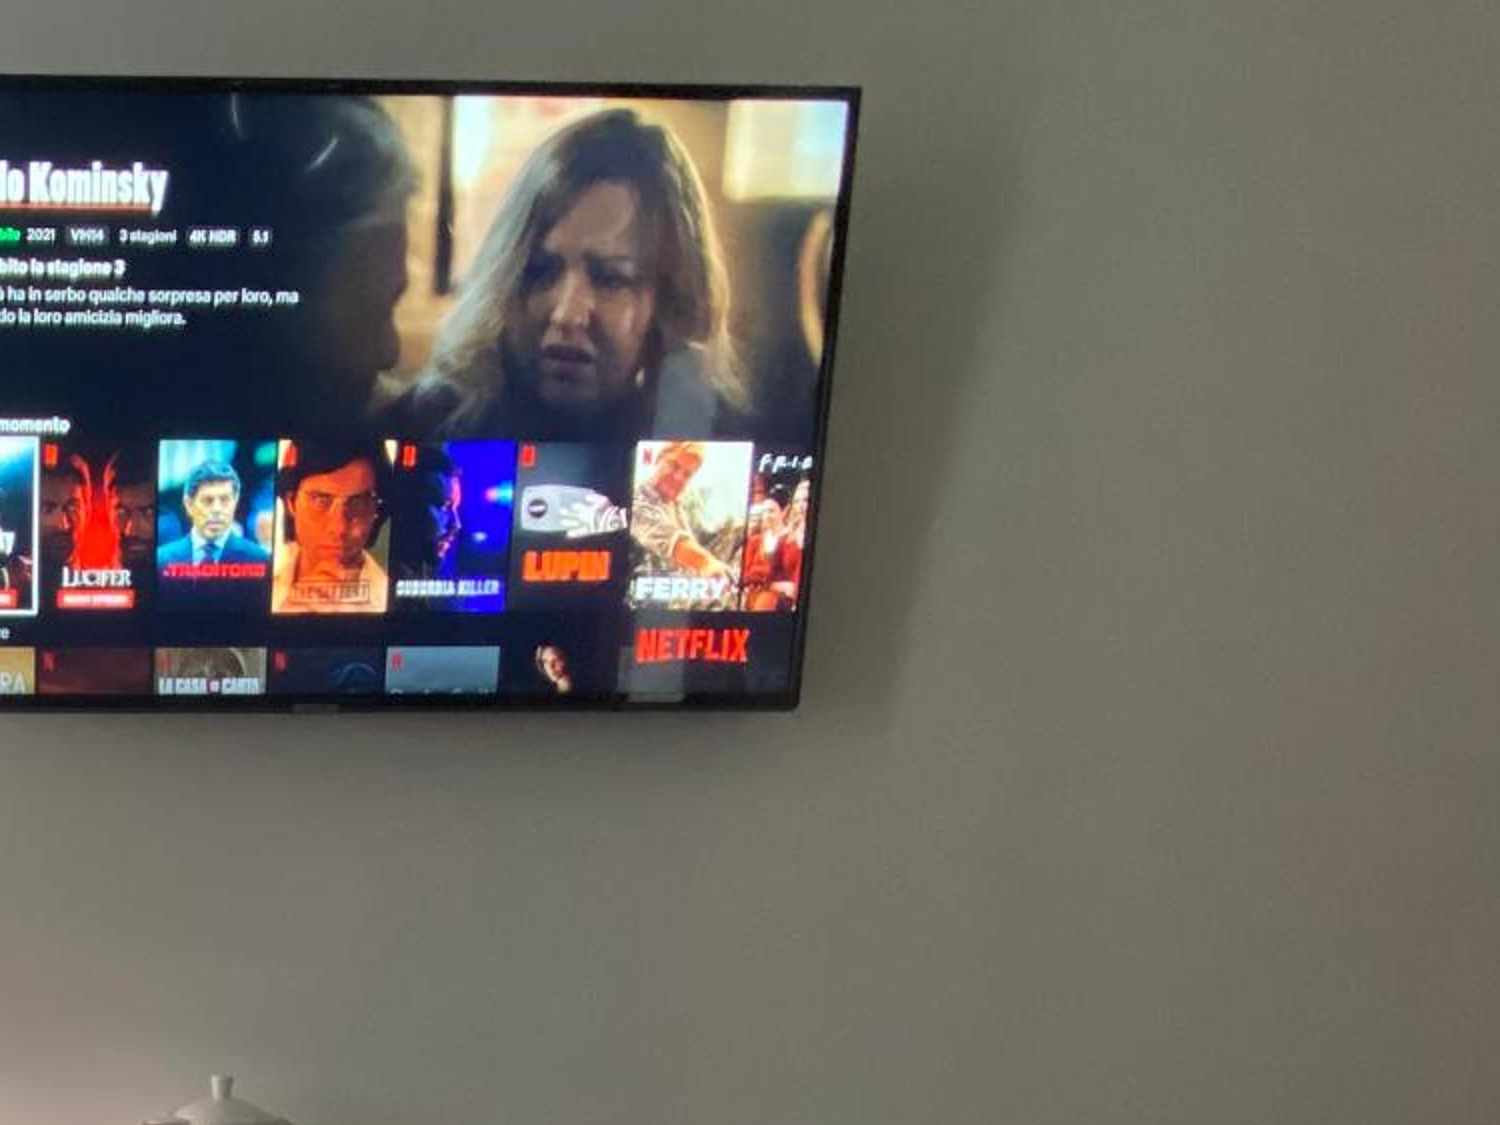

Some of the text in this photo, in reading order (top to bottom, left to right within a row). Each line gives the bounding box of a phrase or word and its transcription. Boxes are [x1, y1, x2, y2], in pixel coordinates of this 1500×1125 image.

[29, 160, 168, 215] Kominsky
[26, 228, 55, 241] 2021
[119, 229, 128, 242] 3
[129, 229, 177, 245] stagioni
[189, 230, 206, 243] 4K
[209, 230, 237, 243] HDR
[30, 258, 45, 276] la
[46, 258, 112, 281] stagione
[114, 259, 126, 277] 3
[7, 286, 26, 301] ha
[28, 286, 42, 301] in
[44, 286, 86, 301] serbo
[88, 286, 146, 305] qualche
[149, 289, 211, 306] sorpresa
[213, 290, 238, 308] per
[241, 288, 273, 306] loro,
[275, 290, 299, 303] ma
[18, 308, 31, 324] la
[33, 308, 63, 324] loro
[64, 309, 123, 325] amicizia
[125, 309, 187, 329] migliora.
[62, 566, 133, 588] LUCIFER
[522, 551, 611, 581] LUPIN
[635, 576, 726, 600] FERRY
[635, 629, 750, 663] NETFLIX
